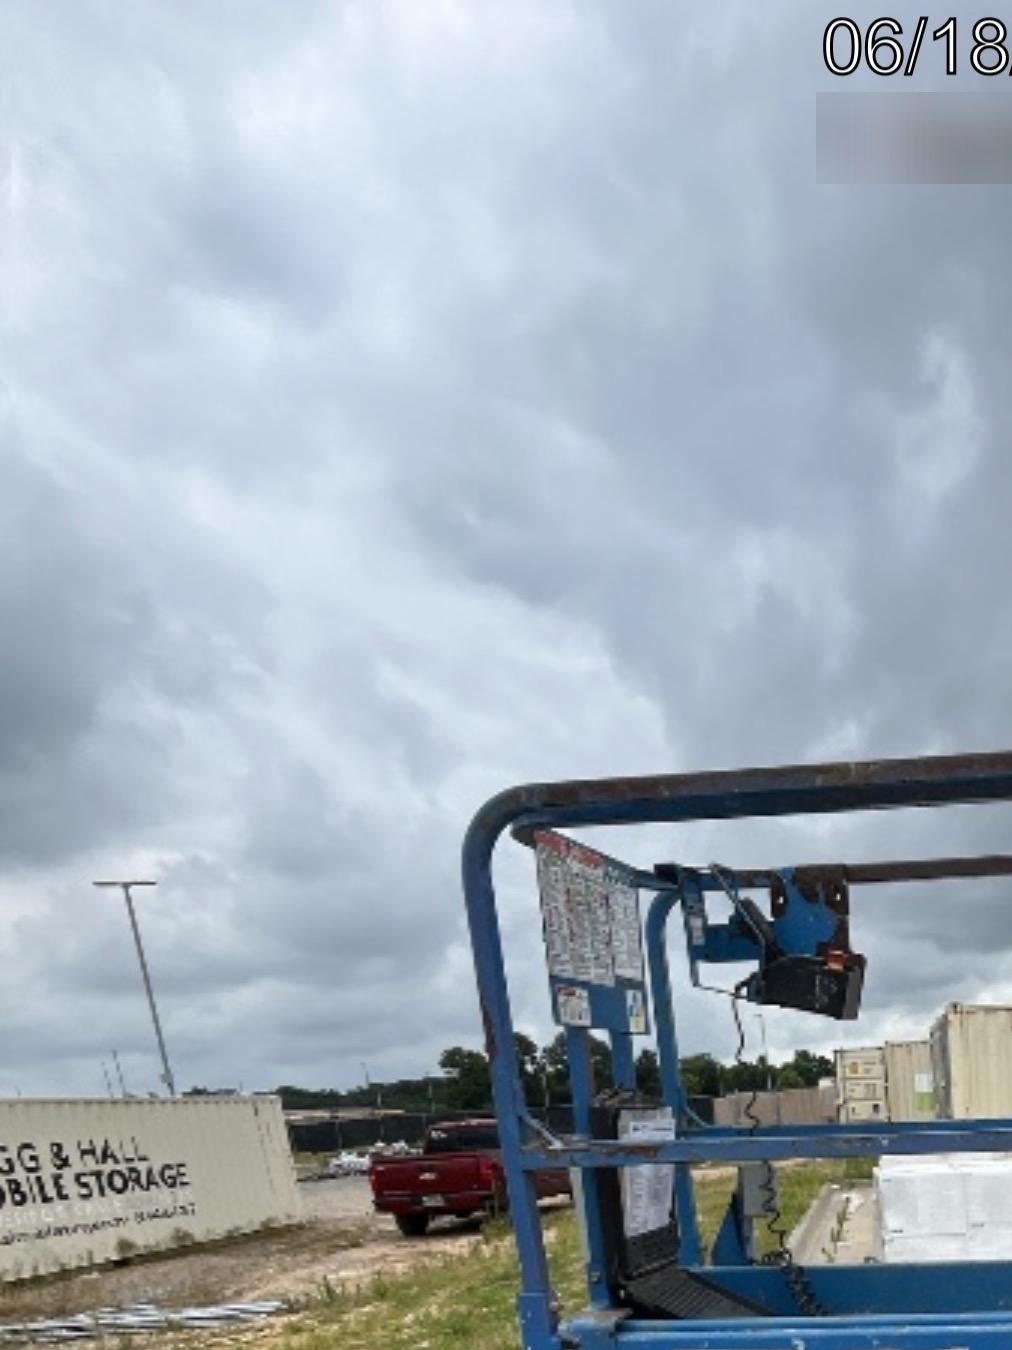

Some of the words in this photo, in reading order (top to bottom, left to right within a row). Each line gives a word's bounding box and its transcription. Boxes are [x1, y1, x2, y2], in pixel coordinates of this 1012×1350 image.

[50, 1142, 71, 1170] &
[77, 1135, 149, 1167] HALL
[74, 1163, 192, 1199] STORAGE
